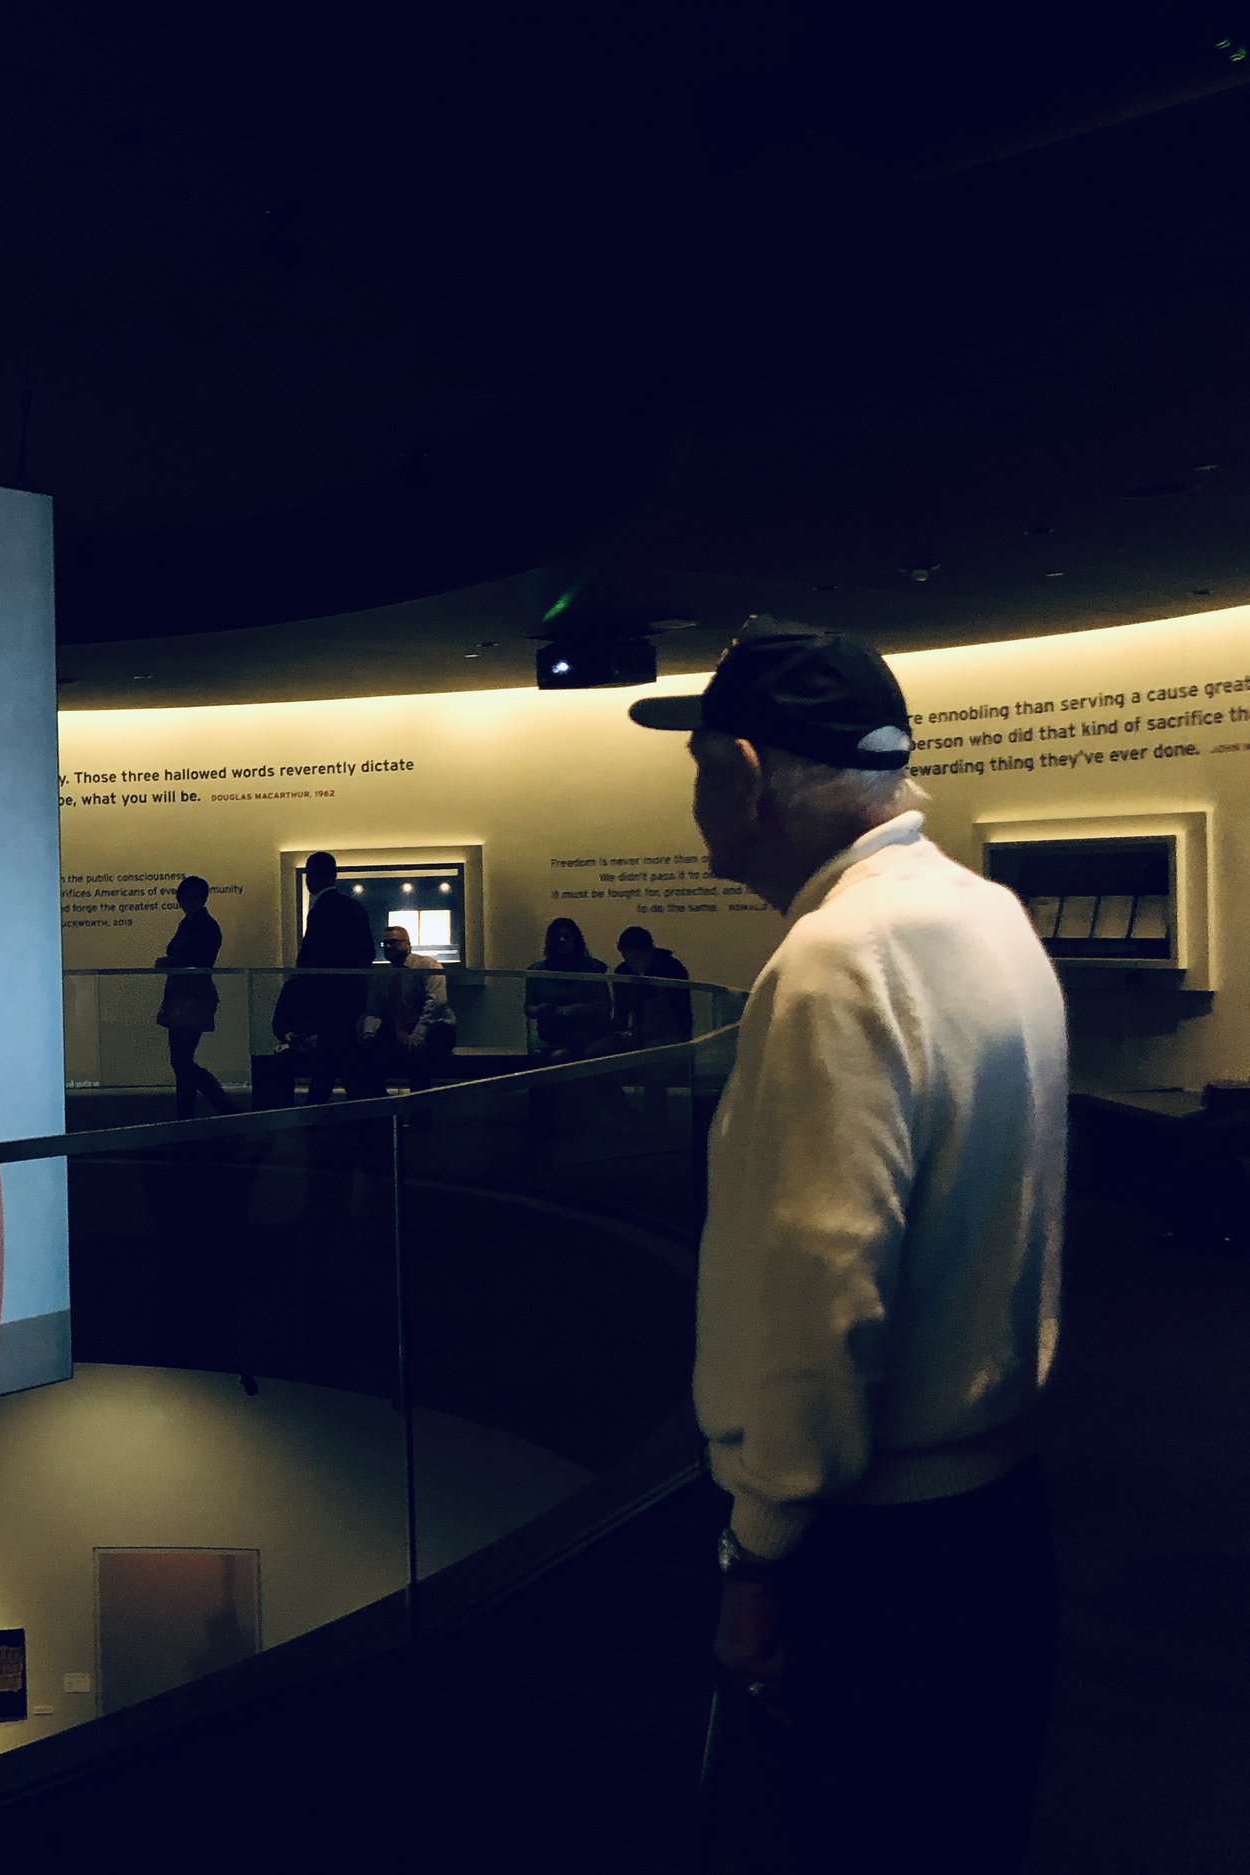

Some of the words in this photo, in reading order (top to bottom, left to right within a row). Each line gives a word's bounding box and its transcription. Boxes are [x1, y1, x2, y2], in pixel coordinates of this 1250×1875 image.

[928, 704, 1009, 723] ennobling
[1014, 700, 1055, 716] than
[1060, 691, 1125, 711] serving
[1130, 691, 1141, 704] a
[1146, 684, 1199, 702] cause
[969, 731, 1003, 746] who
[1008, 727, 1034, 743] did
[1038, 722, 1076, 739] that
[1081, 719, 1119, 736] kind
[1124, 716, 1141, 733] of
[1146, 709, 1224, 731] sacrifice
[989, 756, 1035, 773] thing
[1039, 750, 1104, 770] they've
[1109, 747, 1148, 763] ever
[1153, 743, 1200, 759] done.
[73, 771, 117, 784] Those
[121, 770, 160, 783] three
[164, 766, 227, 781] hallowed
[232, 764, 275, 778] words
[279, 761, 356, 776] reverently
[361, 758, 415, 773] dictate
[81, 792, 116, 806] what
[121, 793, 147, 807] you
[152, 790, 176, 804] will
[181, 790, 201, 802] be.
[211, 793, 252, 802] DOUGLAS
[314, 789, 335, 798] 1962
[68, 874, 84, 883] the
[86, 873, 114, 884] public
[94, 888, 145, 897] Americans
[148, 886, 157, 896] of
[73, 903, 97, 913] forge
[100, 903, 116, 911] the
[118, 902, 158, 912] greatest
